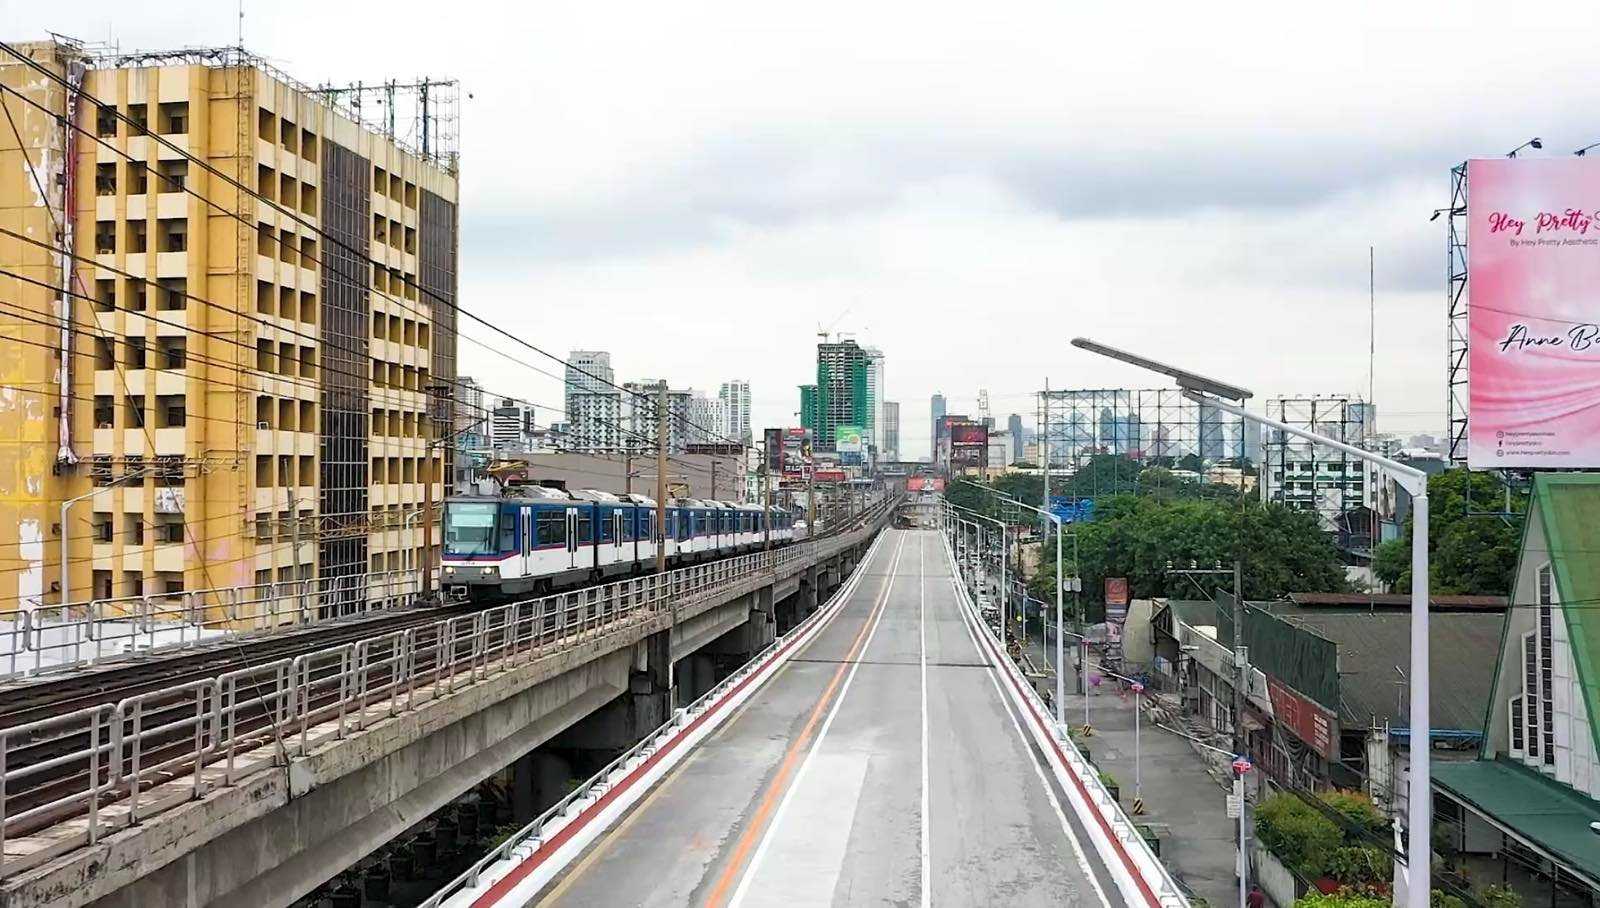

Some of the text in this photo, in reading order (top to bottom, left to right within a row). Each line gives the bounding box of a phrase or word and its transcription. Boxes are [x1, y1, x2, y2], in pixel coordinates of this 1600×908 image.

[1488, 211, 1525, 236] Hey
[1534, 208, 1591, 235] Pretty
[1510, 239, 1519, 247] By
[1521, 239, 1536, 247] Hey
[1537, 238, 1560, 247] Pretty
[1499, 324, 1564, 352] Anne
